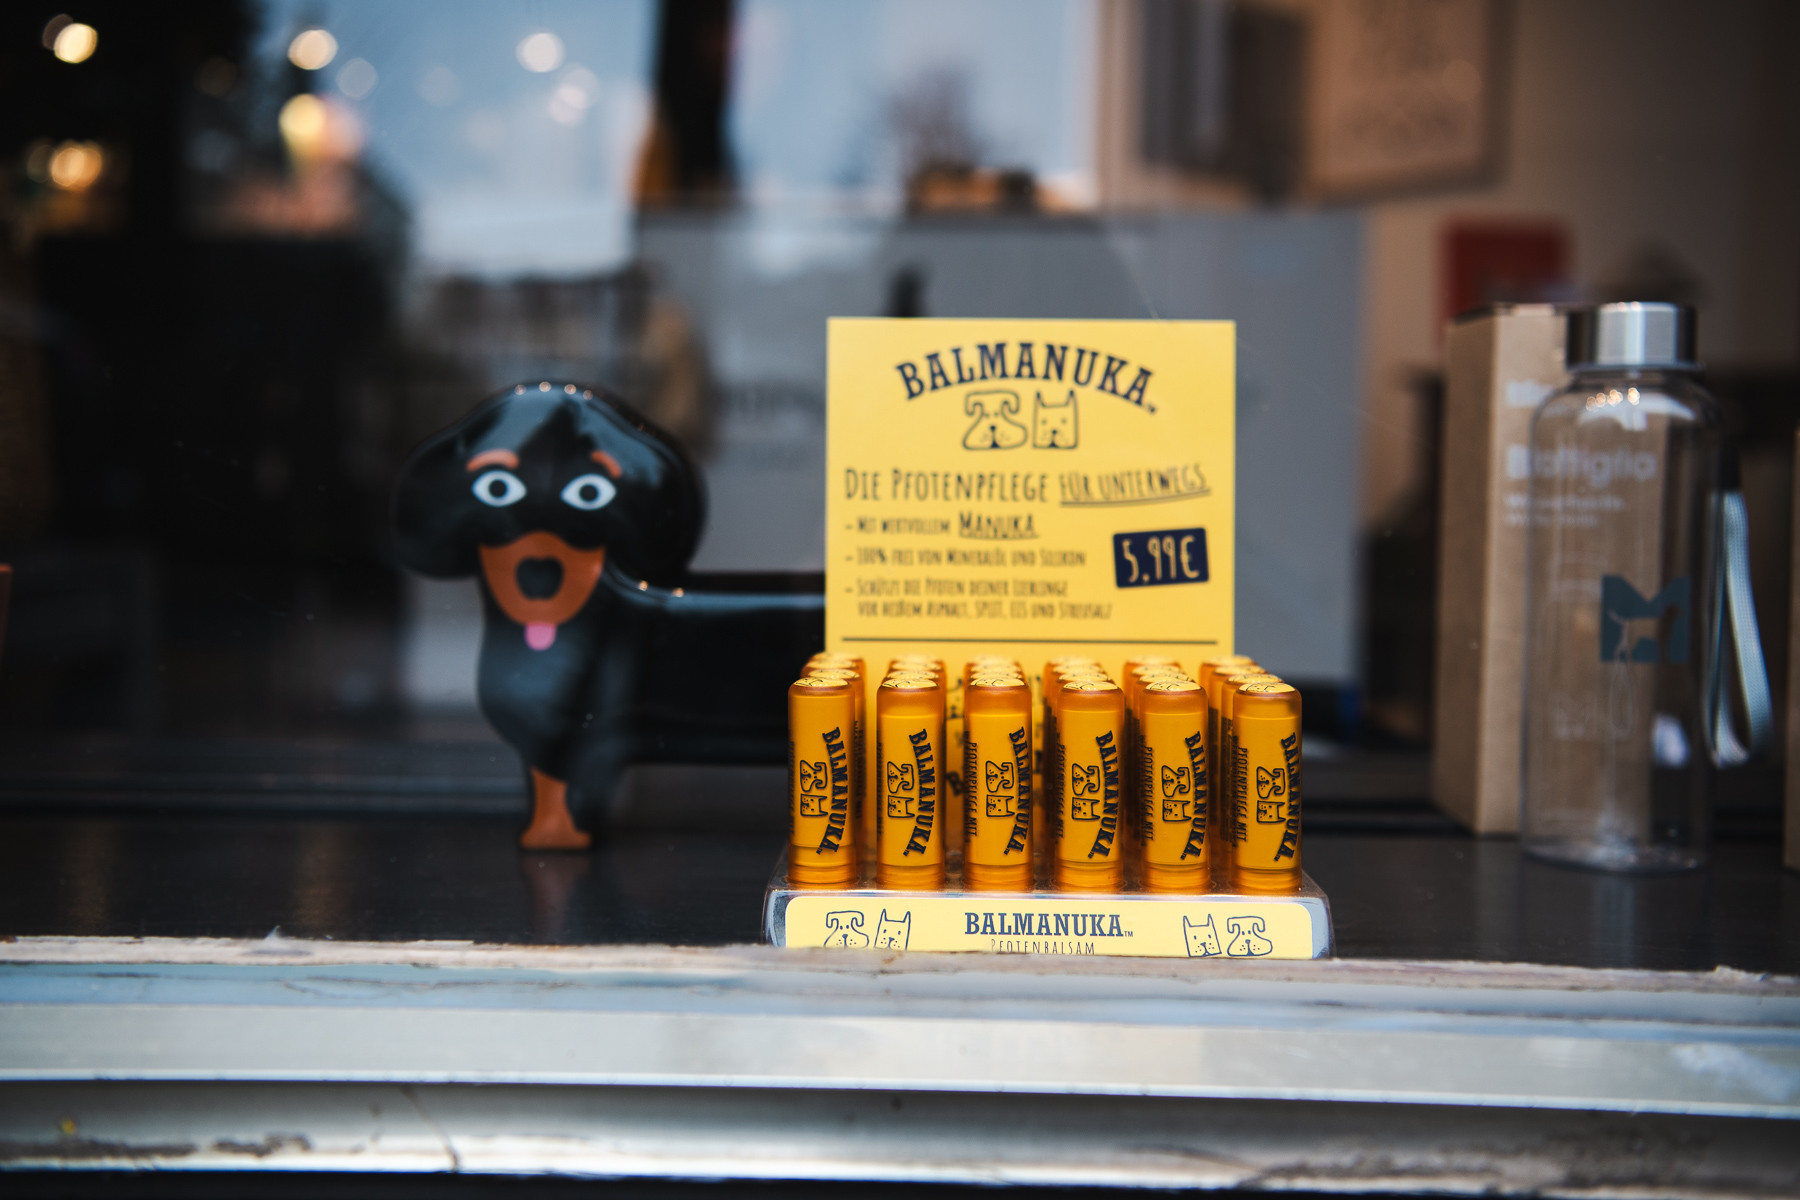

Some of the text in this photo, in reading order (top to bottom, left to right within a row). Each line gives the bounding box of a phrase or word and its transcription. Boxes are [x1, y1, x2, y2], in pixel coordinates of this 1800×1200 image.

[845, 463, 1207, 502] DIE PFOTENPFLEGE FÜR UNTERWEGS
[959, 511, 1035, 538] MANUKA
[1122, 535, 1200, 584] 5.99€
